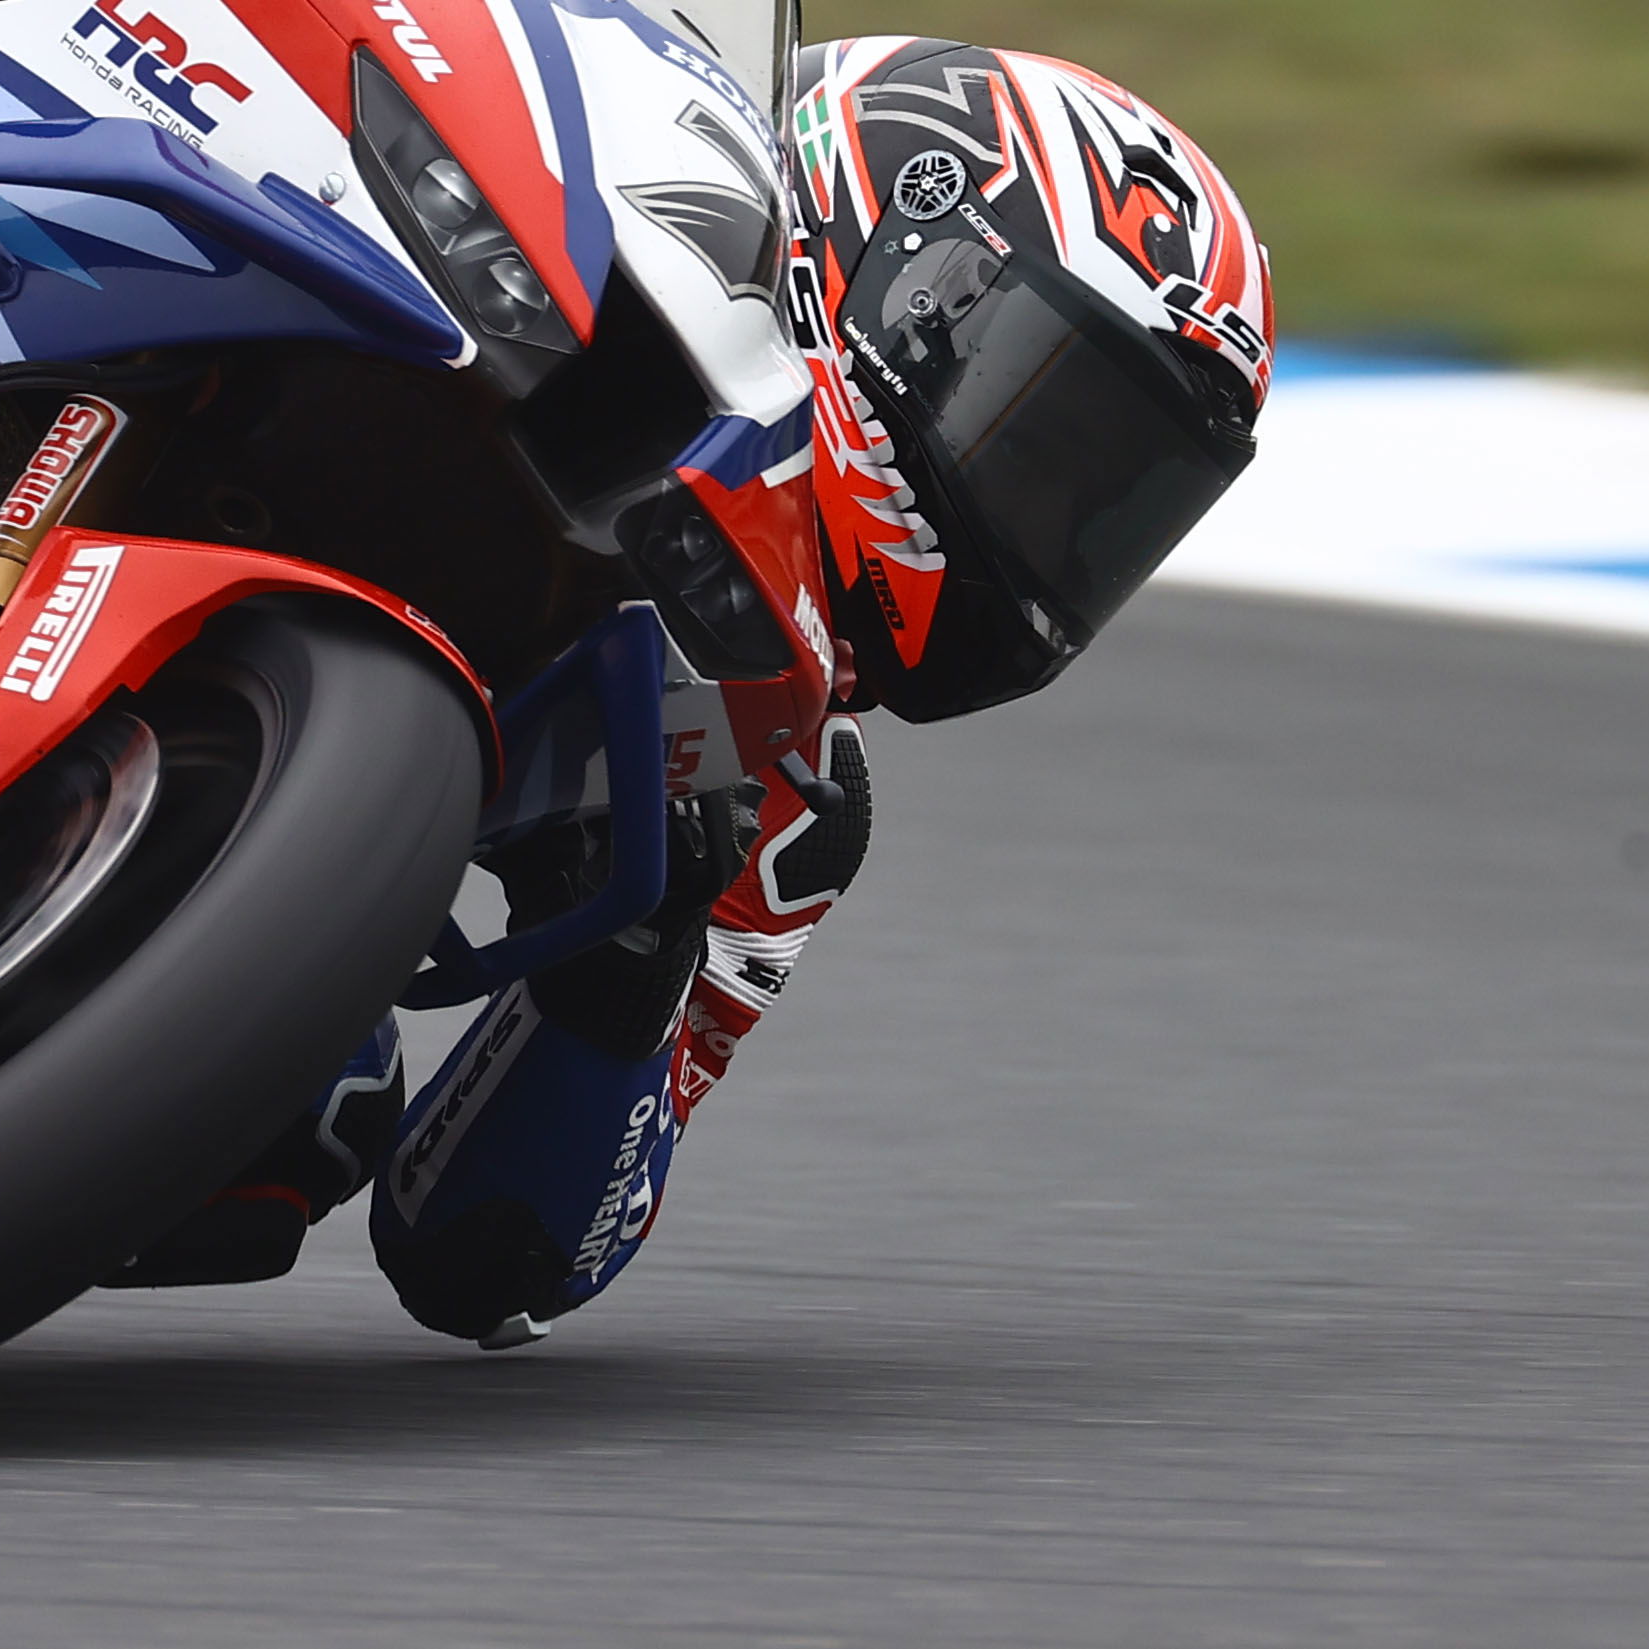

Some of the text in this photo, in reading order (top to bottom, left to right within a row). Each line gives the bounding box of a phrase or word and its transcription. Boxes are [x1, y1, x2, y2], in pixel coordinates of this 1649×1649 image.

[60, 33, 204, 149] Honda RACING
[957, 203, 1013, 257] LS2
[0, 545, 125, 701] PIRELLI
[613, 1095, 655, 1169] One
